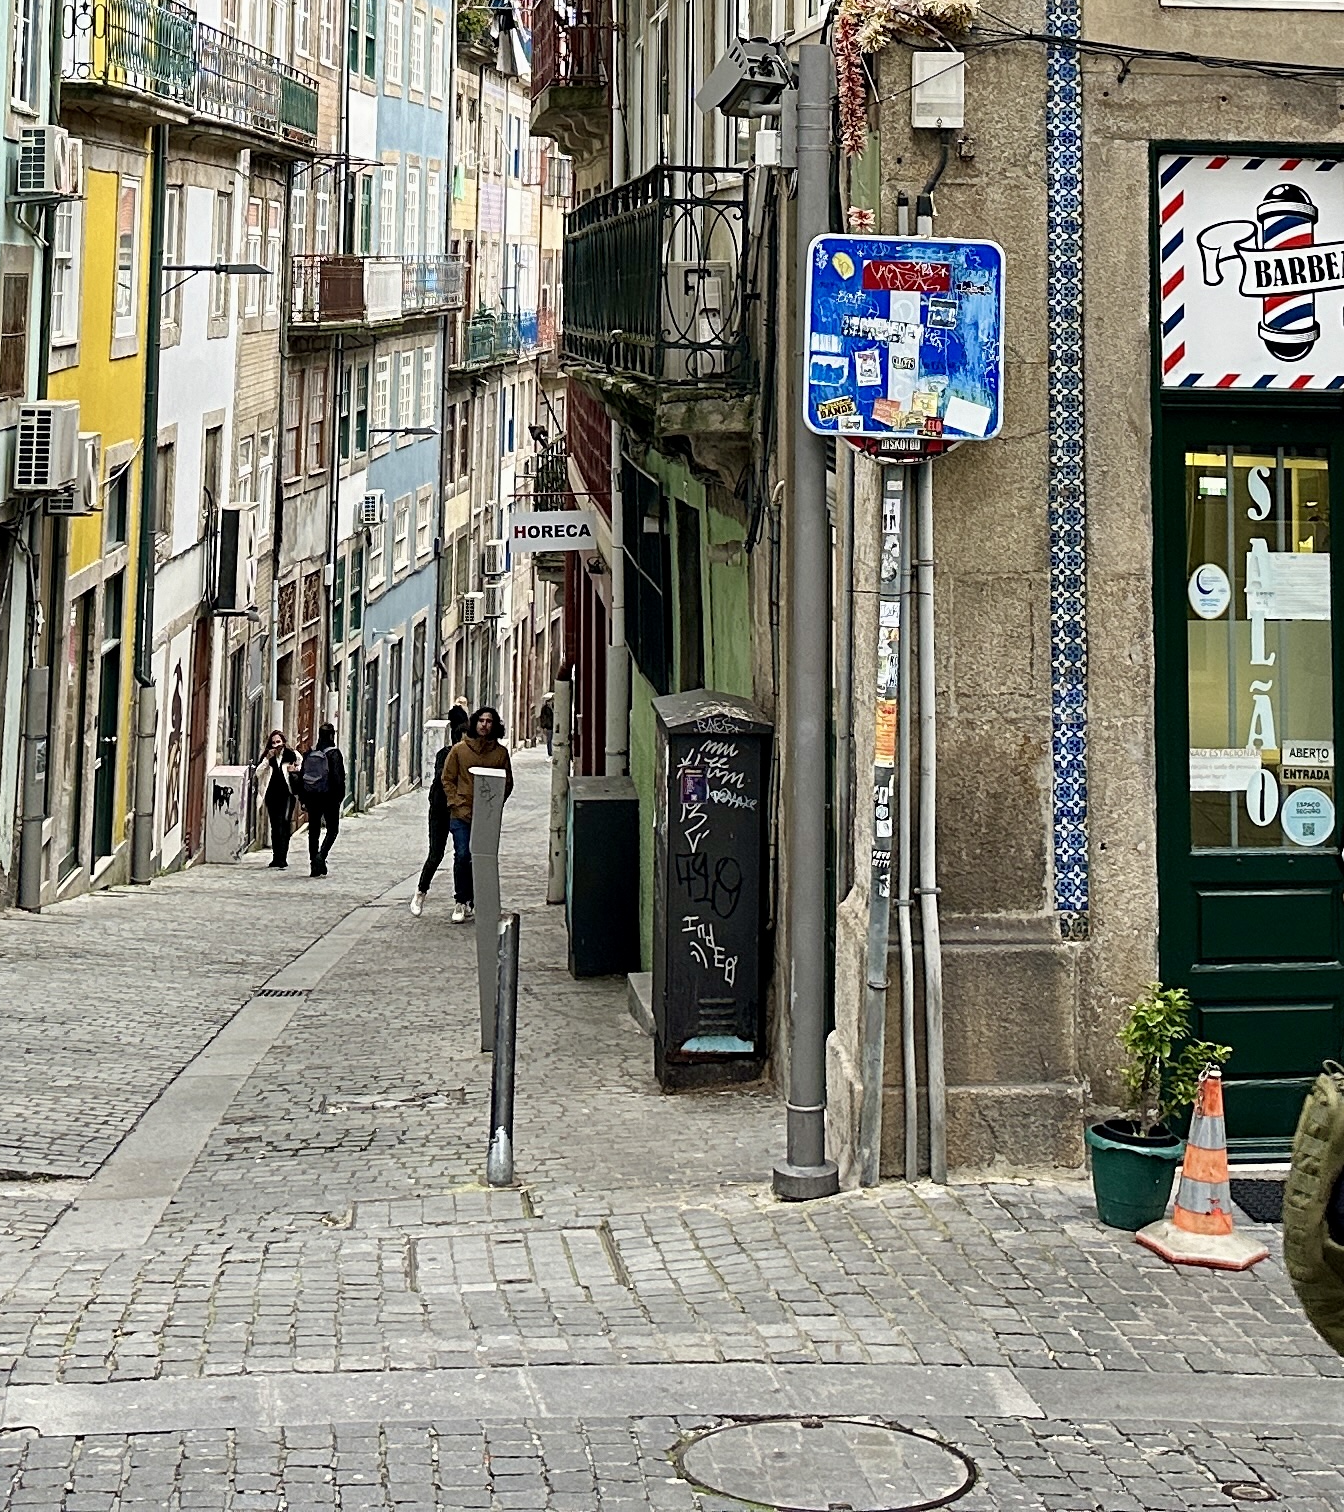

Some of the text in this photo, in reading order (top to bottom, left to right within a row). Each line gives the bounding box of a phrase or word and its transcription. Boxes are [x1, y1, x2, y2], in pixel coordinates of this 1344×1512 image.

[514, 523, 592, 539] HORECA
[1289, 747, 1330, 759] ABERTO
[1283, 768, 1330, 780] ENTRADA
